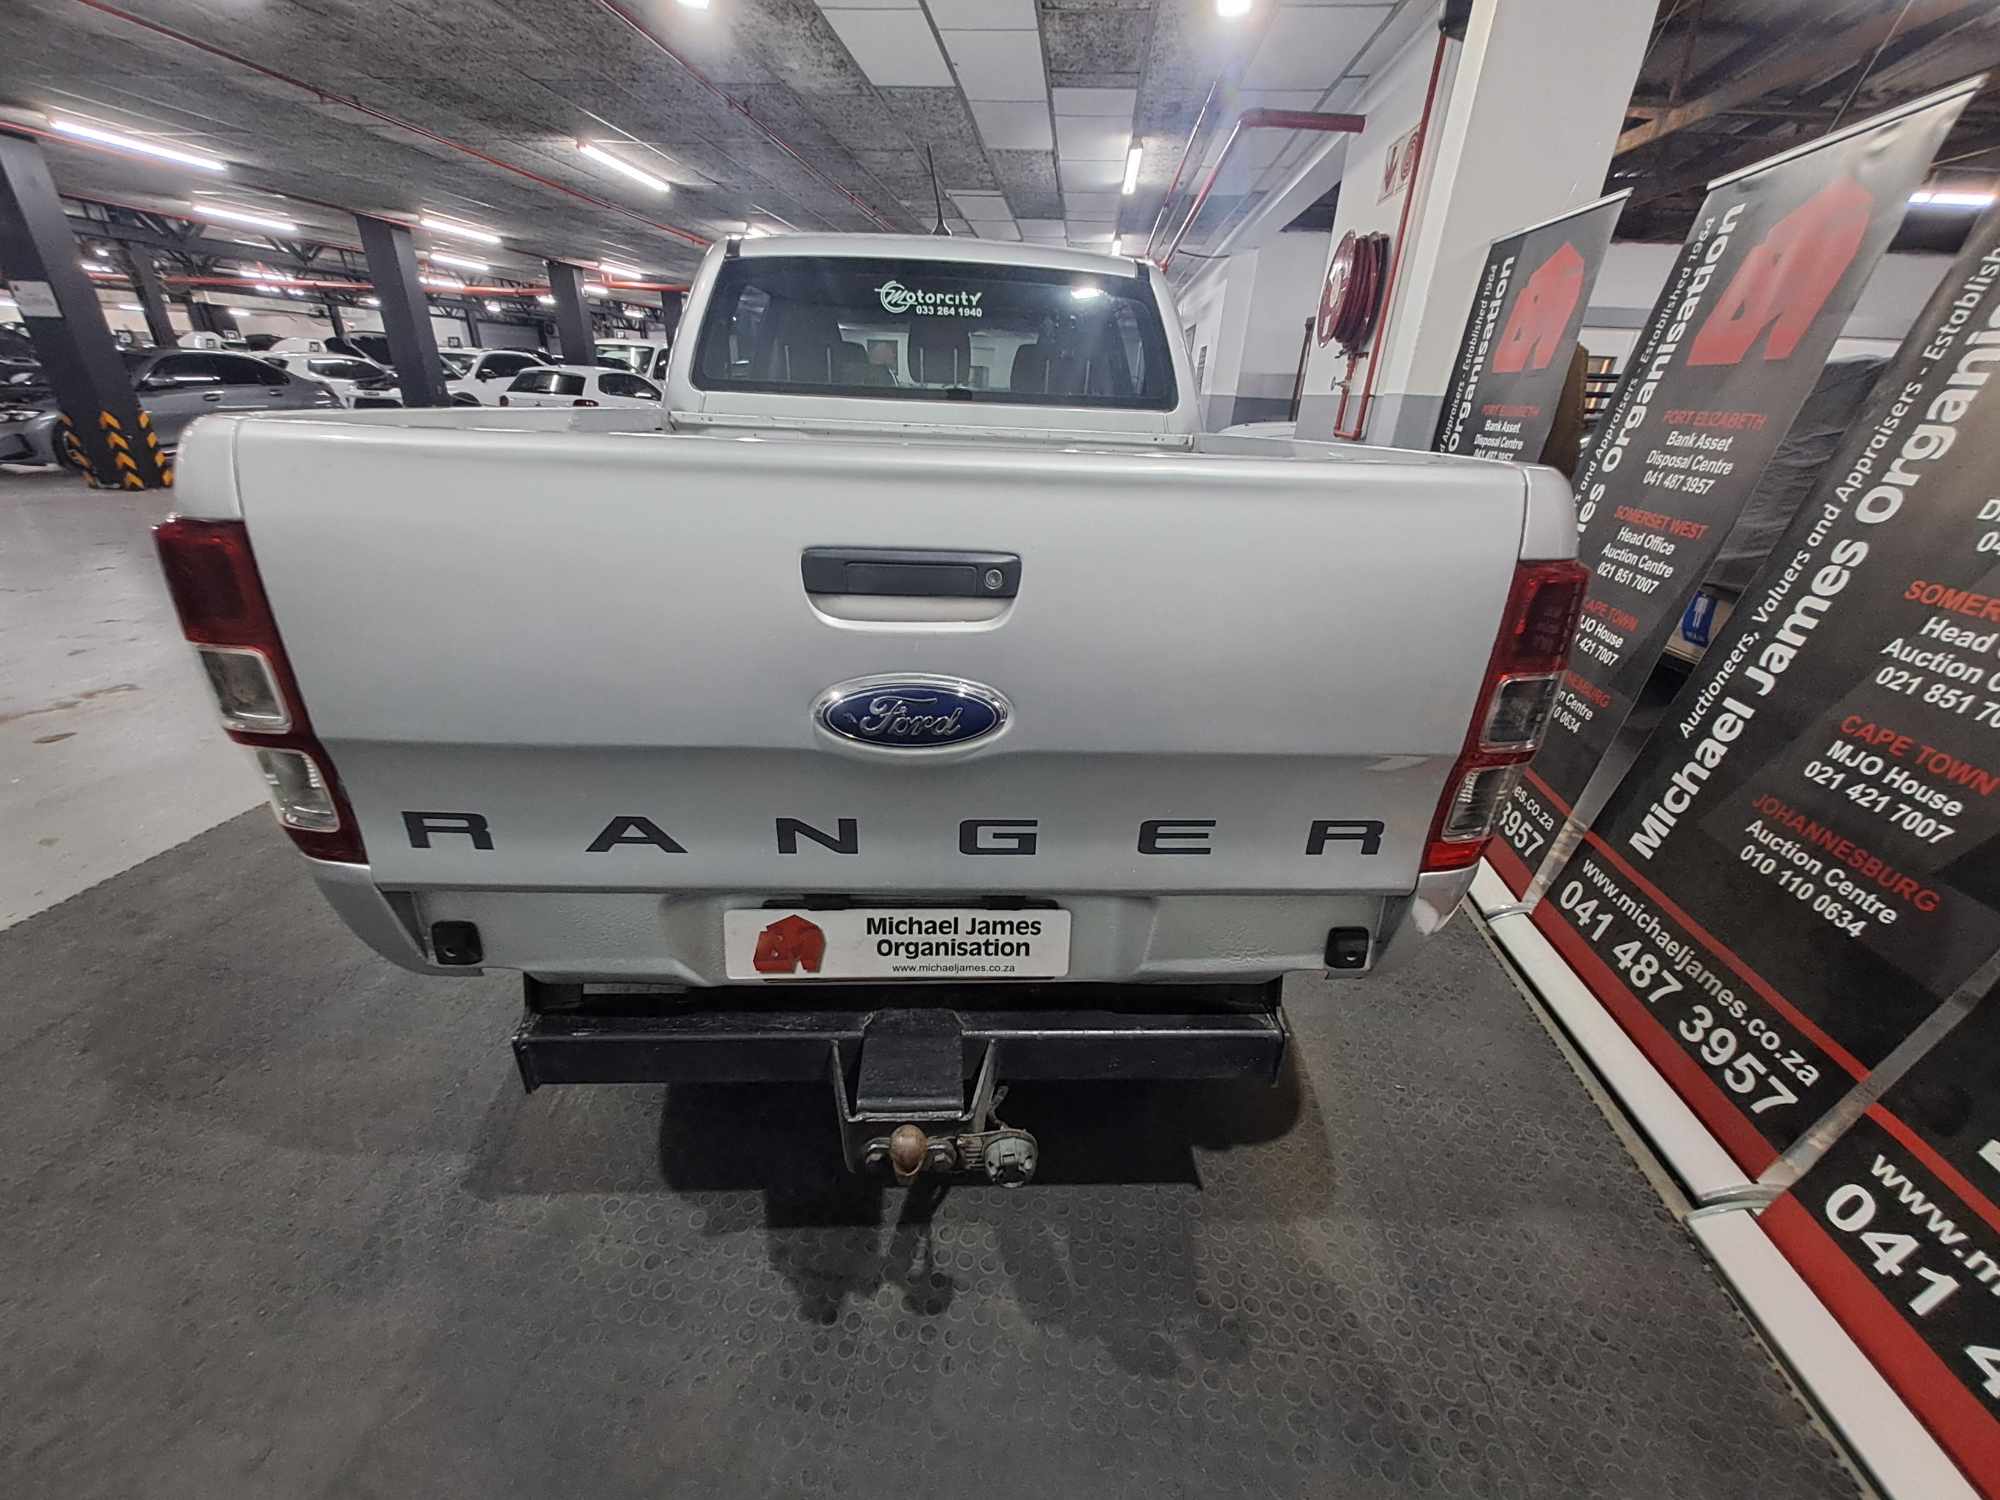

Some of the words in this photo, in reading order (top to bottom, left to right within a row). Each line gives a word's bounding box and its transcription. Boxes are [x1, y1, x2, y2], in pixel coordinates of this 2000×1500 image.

[916, 305, 934, 315] 033
[958, 307, 983, 317] 1940
[1448, 256, 1516, 452] Organisation
[1602, 203, 1747, 473] Organisation
[1581, 461, 1597, 490] and
[1595, 378, 1640, 458] Appraisers
[1640, 267, 1691, 364] Established
[1484, 419, 1502, 432] Bank
[1500, 421, 1521, 434] Asset
[1666, 431, 1696, 448] Bank
[1694, 433, 1734, 451] Asset
[1643, 470, 1665, 486] 041
[1663, 473, 1684, 491] 487
[1682, 477, 1715, 495] 3957
[1646, 450, 1693, 473] Disposal
[1691, 455, 1734, 476] Centre
[1617, 526, 1645, 547] Head
[1643, 533, 1676, 556] Office
[1669, 515, 1710, 540] WEST
[1597, 561, 1616, 577] 021
[1615, 567, 1633, 584] 851
[1631, 572, 1660, 595] 7007
[1602, 542, 1639, 566] Auction
[1637, 555, 1675, 578] Centre
[1679, 631, 1762, 739] Auctioneers,
[1752, 549, 1811, 625] Valuers
[1807, 503, 1841, 548] and
[1834, 381, 1923, 504] Appraisers
[1594, 624, 1625, 650] House
[1607, 606, 1640, 633] TOWN
[1919, 616, 1999, 654] Head
[1579, 637, 1597, 653] 421
[1594, 644, 1620, 667] 7007
[1880, 638, 1985, 685] Auction
[1566, 691, 1594, 721] Centre
[1629, 696, 1756, 860] Michael
[1745, 540, 1870, 696] James
[1876, 666, 1924, 695] 021
[1923, 683, 1976, 714] 851
[855, 695, 964, 736] Ford
[1560, 711, 1582, 734] 0634
[1840, 714, 1916, 757] CAPE
[1913, 744, 2000, 797] TOWN
[1826, 739, 1885, 776] MJO
[1881, 765, 1964, 817] House
[1512, 785, 1555, 831] es.co.za
[1804, 760, 1848, 791] 021
[1845, 783, 1892, 814] 421
[1889, 802, 1956, 845] 7007
[401, 811, 1385, 856] RANGER
[1752, 793, 1941, 912] JOHANNESBURG
[1739, 844, 1778, 875] 010
[1778, 869, 1815, 901] 110
[1812, 894, 1868, 938] 0634
[1744, 819, 1824, 876] Auction
[1823, 868, 1898, 925] Centre
[866, 917, 959, 936] Michael
[966, 917, 1041, 936] James
[876, 938, 1031, 959] Organisation
[892, 963, 1015, 975] www.michaeljames.co.za
[1581, 859, 1821, 1088] www.michaeljames.co.za
[1559, 880, 1615, 942] 041
[1612, 939, 1684, 1003] 487
[1678, 1004, 1799, 1114] 3957
[1825, 1183, 1960, 1317] 041
